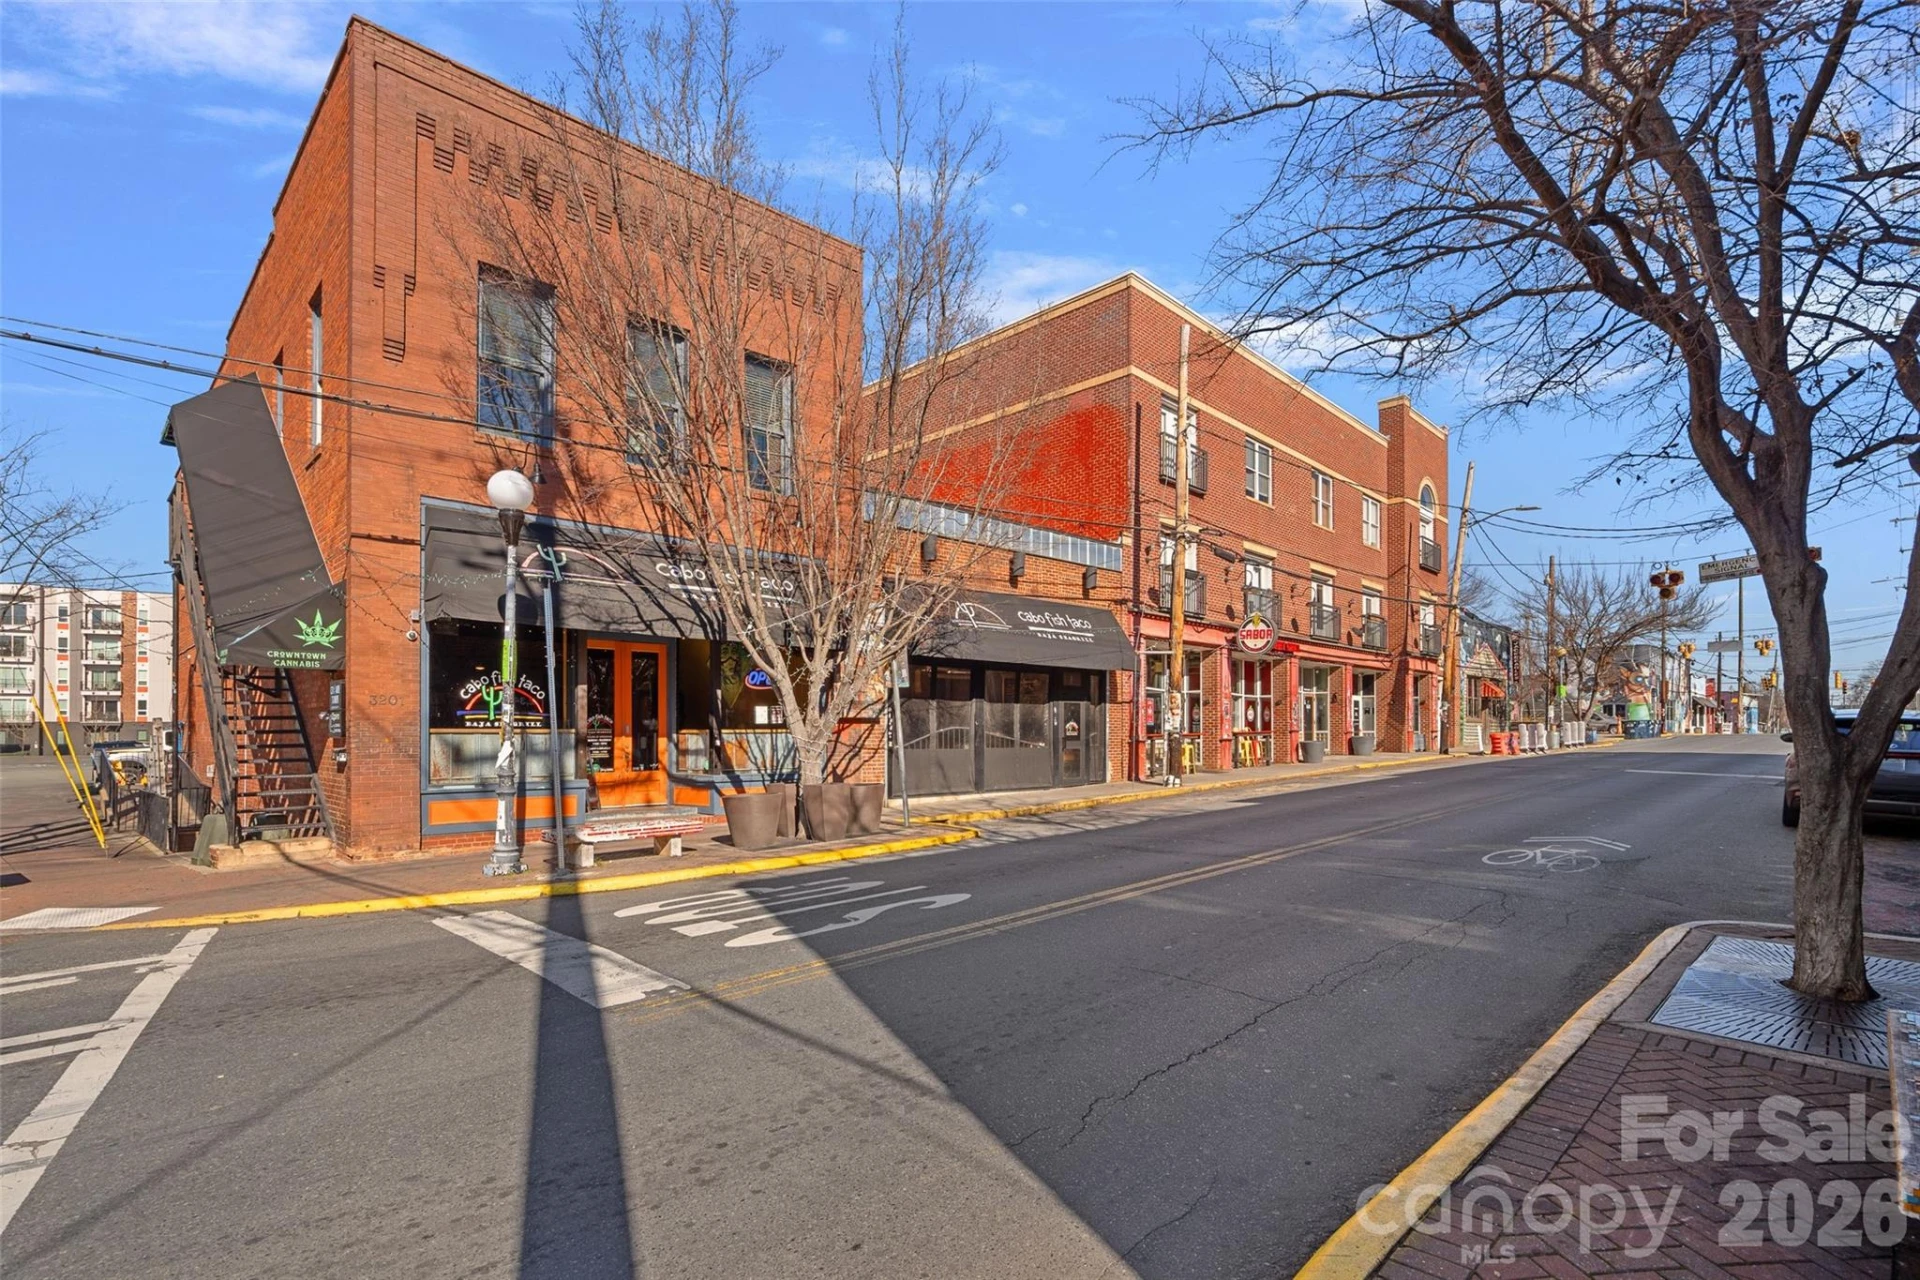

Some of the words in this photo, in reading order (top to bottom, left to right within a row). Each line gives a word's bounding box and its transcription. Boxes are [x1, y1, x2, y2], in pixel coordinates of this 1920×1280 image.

[1701, 557, 1757, 571] EMERGENC
[1714, 563, 1749, 574] SIGNAL
[1017, 611, 1046, 625] cabo
[1044, 612, 1069, 628] fish
[1065, 614, 1093, 629] taco
[1239, 628, 1273, 640] SABOR
[266, 650, 327, 660] CROWNTOWN
[273, 659, 321, 668] CANNABIS
[748, 670, 772, 686] OP
[460, 675, 490, 699] cabo
[518, 674, 546, 699] taco
